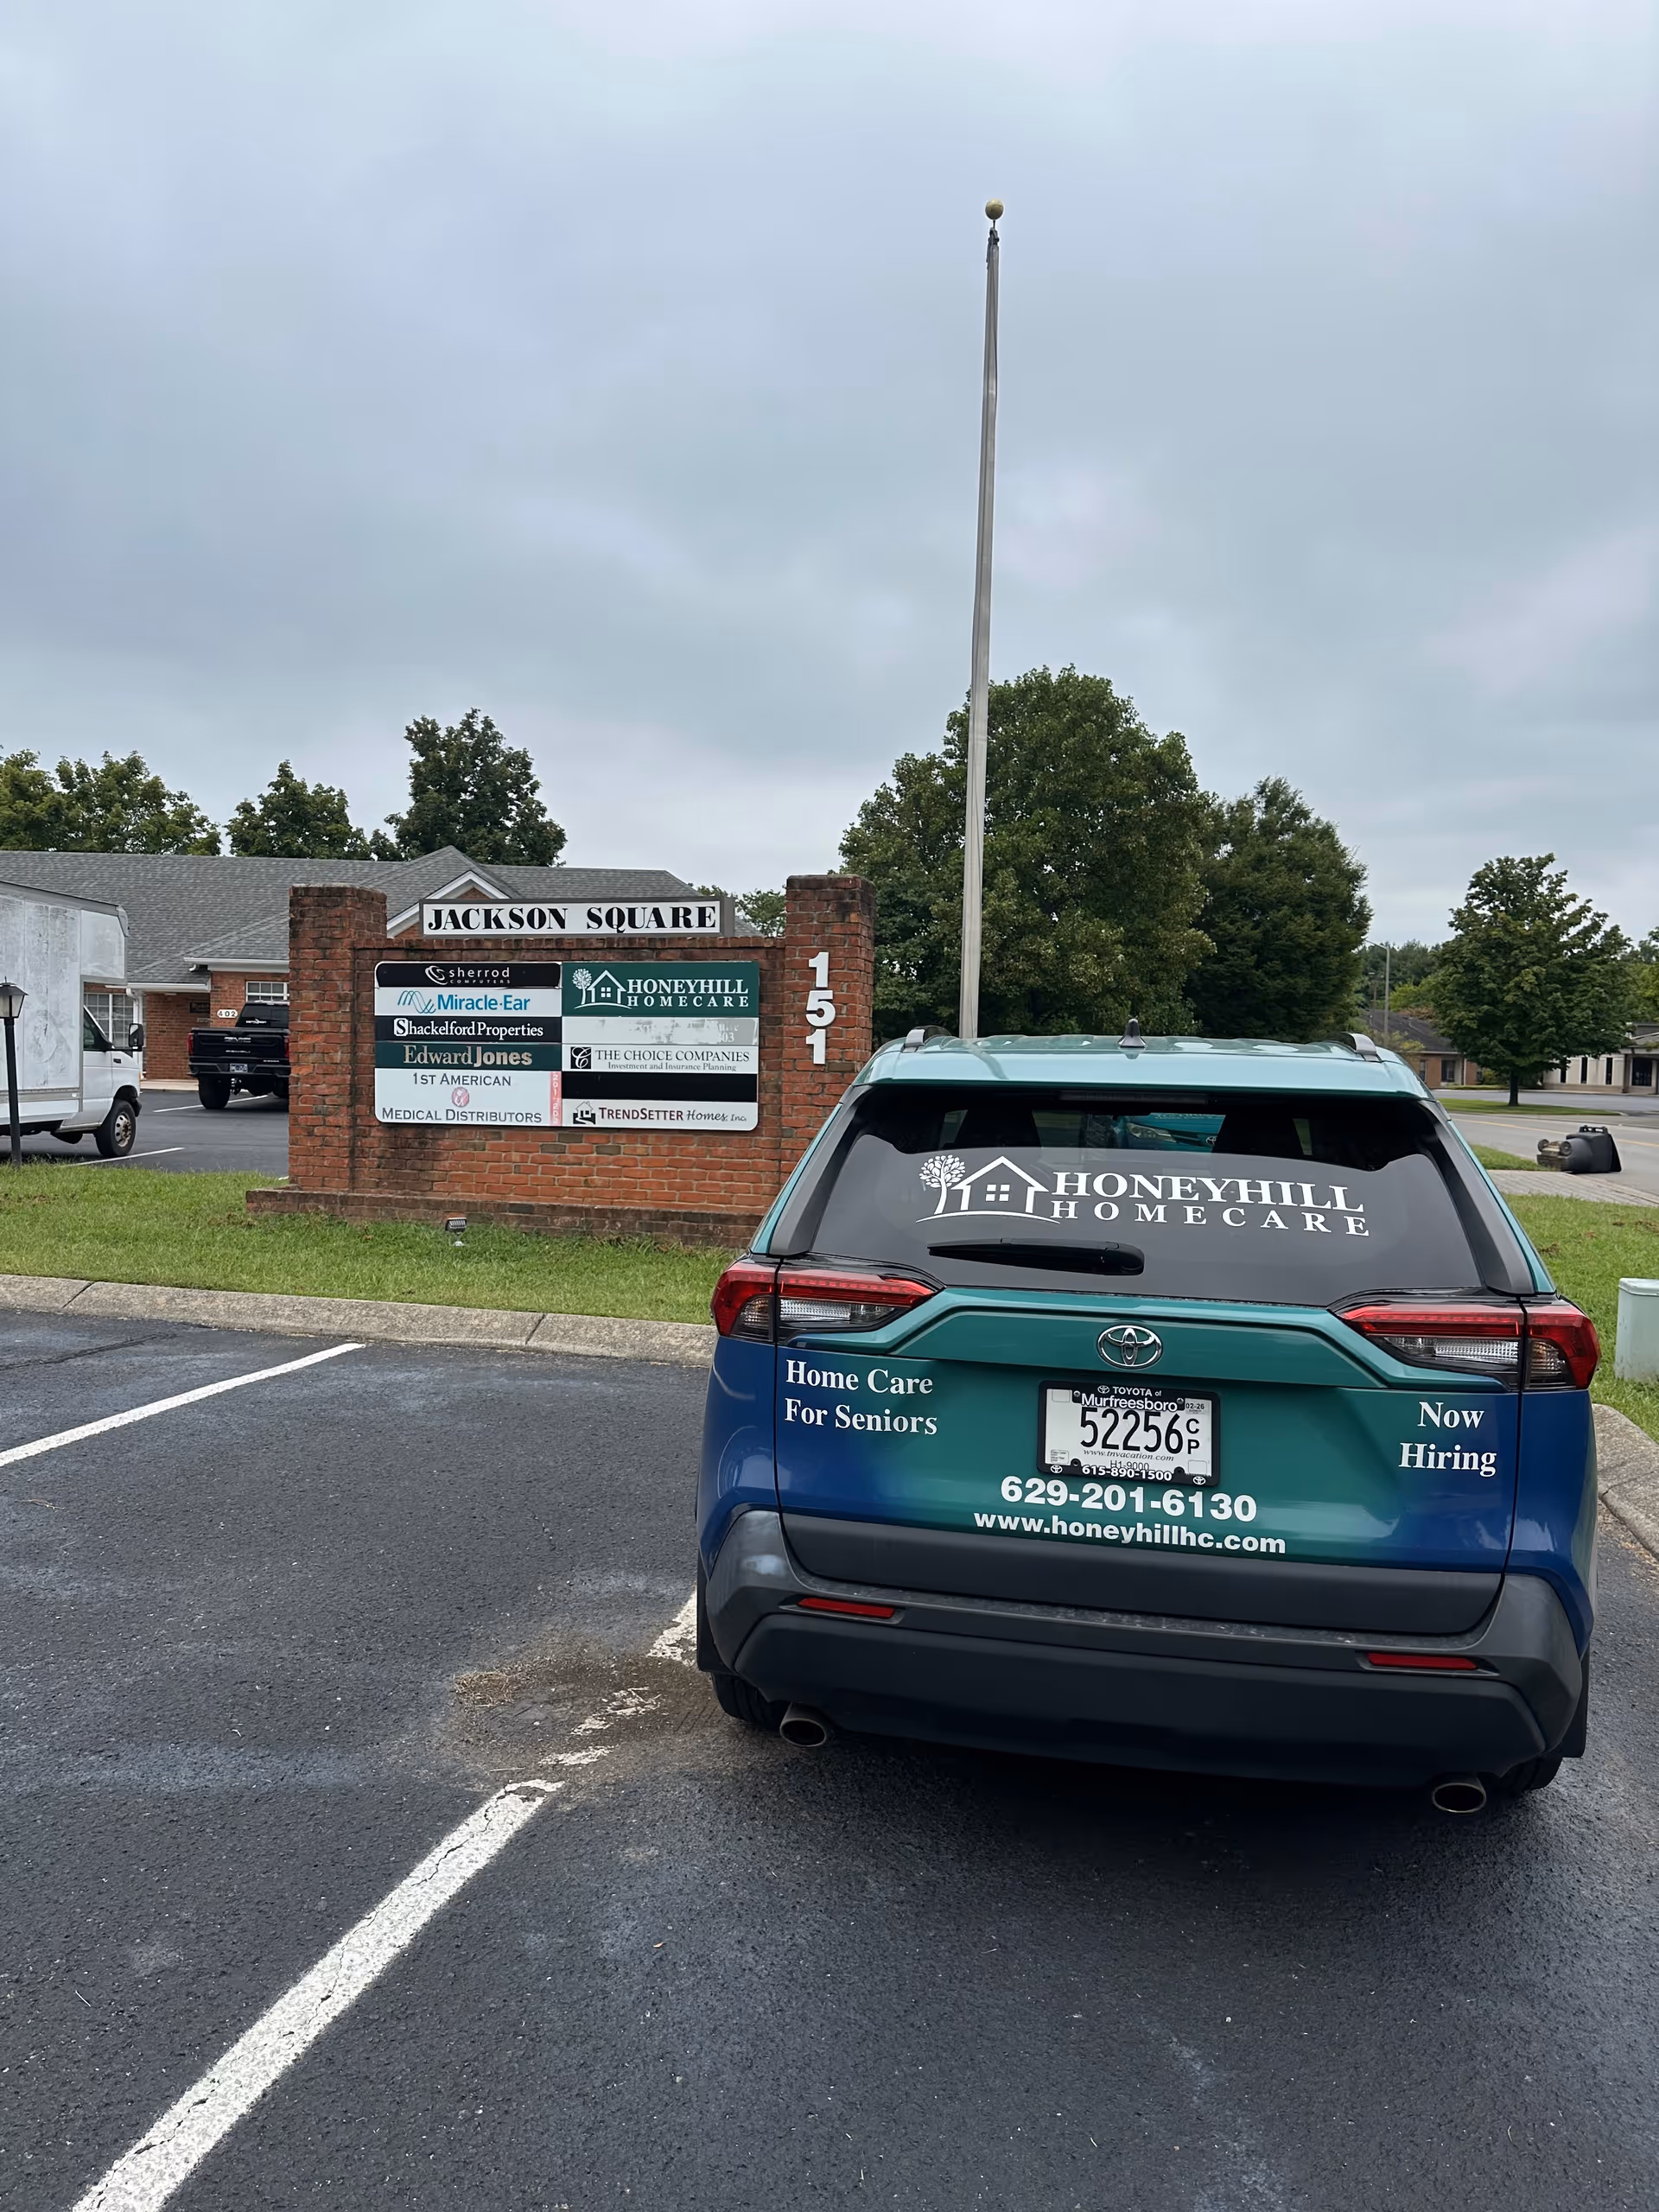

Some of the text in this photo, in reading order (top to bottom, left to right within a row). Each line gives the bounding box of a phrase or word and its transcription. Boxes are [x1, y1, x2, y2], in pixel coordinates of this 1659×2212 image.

[428, 906, 716, 933] JACKSON SQUARE
[449, 967, 510, 978] sherrod
[626, 979, 748, 995] HONEYHILL
[627, 995, 749, 1007] HOMECARE
[805, 951, 836, 1065] 151
[394, 1018, 543, 1040] Shackelford Properties
[403, 1045, 533, 1067] Edward Jones
[595, 1050, 750, 1063] THE CHOICE COMPANIES
[413, 1072, 512, 1086] 1ST AMERICAN
[382, 1108, 543, 1123] MEDICAL DISTRIBUTORS
[598, 1107, 683, 1122] TRENDSETTER
[1051, 1171, 1364, 1213] HONEYHILL
[1050, 1200, 1370, 1237] HOMECARE
[785, 1359, 933, 1395] Home Care
[1081, 1393, 1178, 1412] Murfreesboro
[1112, 1386, 1153, 1397] TOYOTA
[785, 1397, 938, 1435] For Seniors
[1417, 1401, 1484, 1428] Now
[1080, 1406, 1184, 1454] 52256
[1083, 1448, 1174, 1462] www.tnvacation.com
[1398, 1442, 1497, 1477] Hiring
[1082, 1465, 1173, 1482] 615-890-1500
[1001, 1475, 1257, 1522] 629-201-6130
[974, 1512, 1286, 1554] www.honeyhillhc.com
